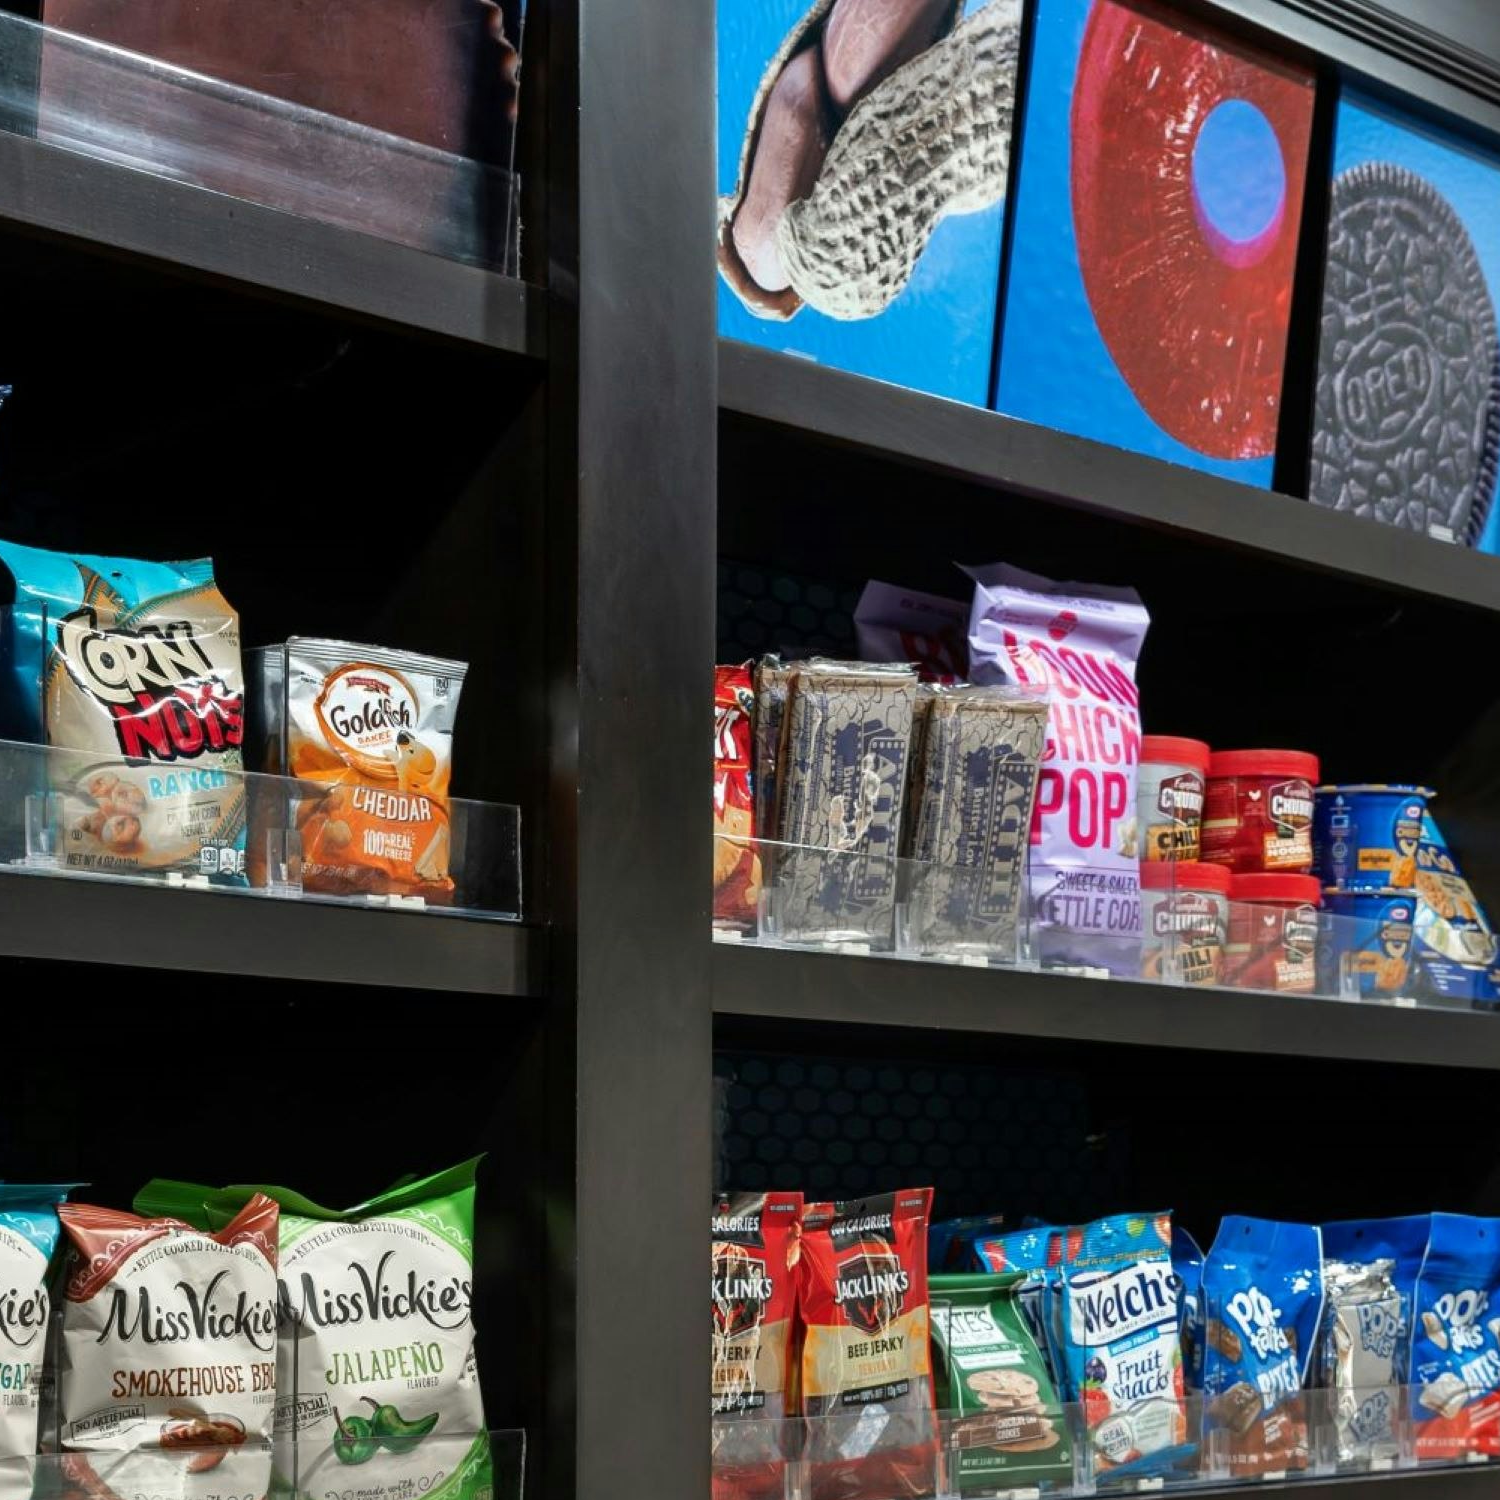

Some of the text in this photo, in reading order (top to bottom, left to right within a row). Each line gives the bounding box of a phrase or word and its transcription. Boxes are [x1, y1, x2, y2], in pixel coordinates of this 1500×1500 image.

[60, 613, 209, 703] CORN
[109, 684, 244, 758] NUTS
[331, 698, 411, 738] Goldfish
[150, 767, 227, 799] RANCH
[353, 787, 432, 821] CHEDDAR
[1030, 768, 1128, 849] POP
[1056, 870, 1096, 893] SWEET
[1048, 894, 1102, 928] ETTLE
[846, 1213, 892, 1233] CALORIES
[163, 1240, 203, 1256] COOKED
[348, 1250, 473, 1330] Vickie's
[1077, 1270, 1184, 1334] Welch's
[96, 1286, 191, 1343] Miss
[326, 1341, 445, 1386] JALAPEÑO
[847, 1335, 905, 1359] BEEF JERKY
[112, 1366, 246, 1398] SMOKEHOUSE
[1117, 1349, 1163, 1385] Fruit
[1113, 1369, 1170, 1408] Snacks
[75, 1418, 91, 1431] NO
[388, 1478, 416, 1495] with
